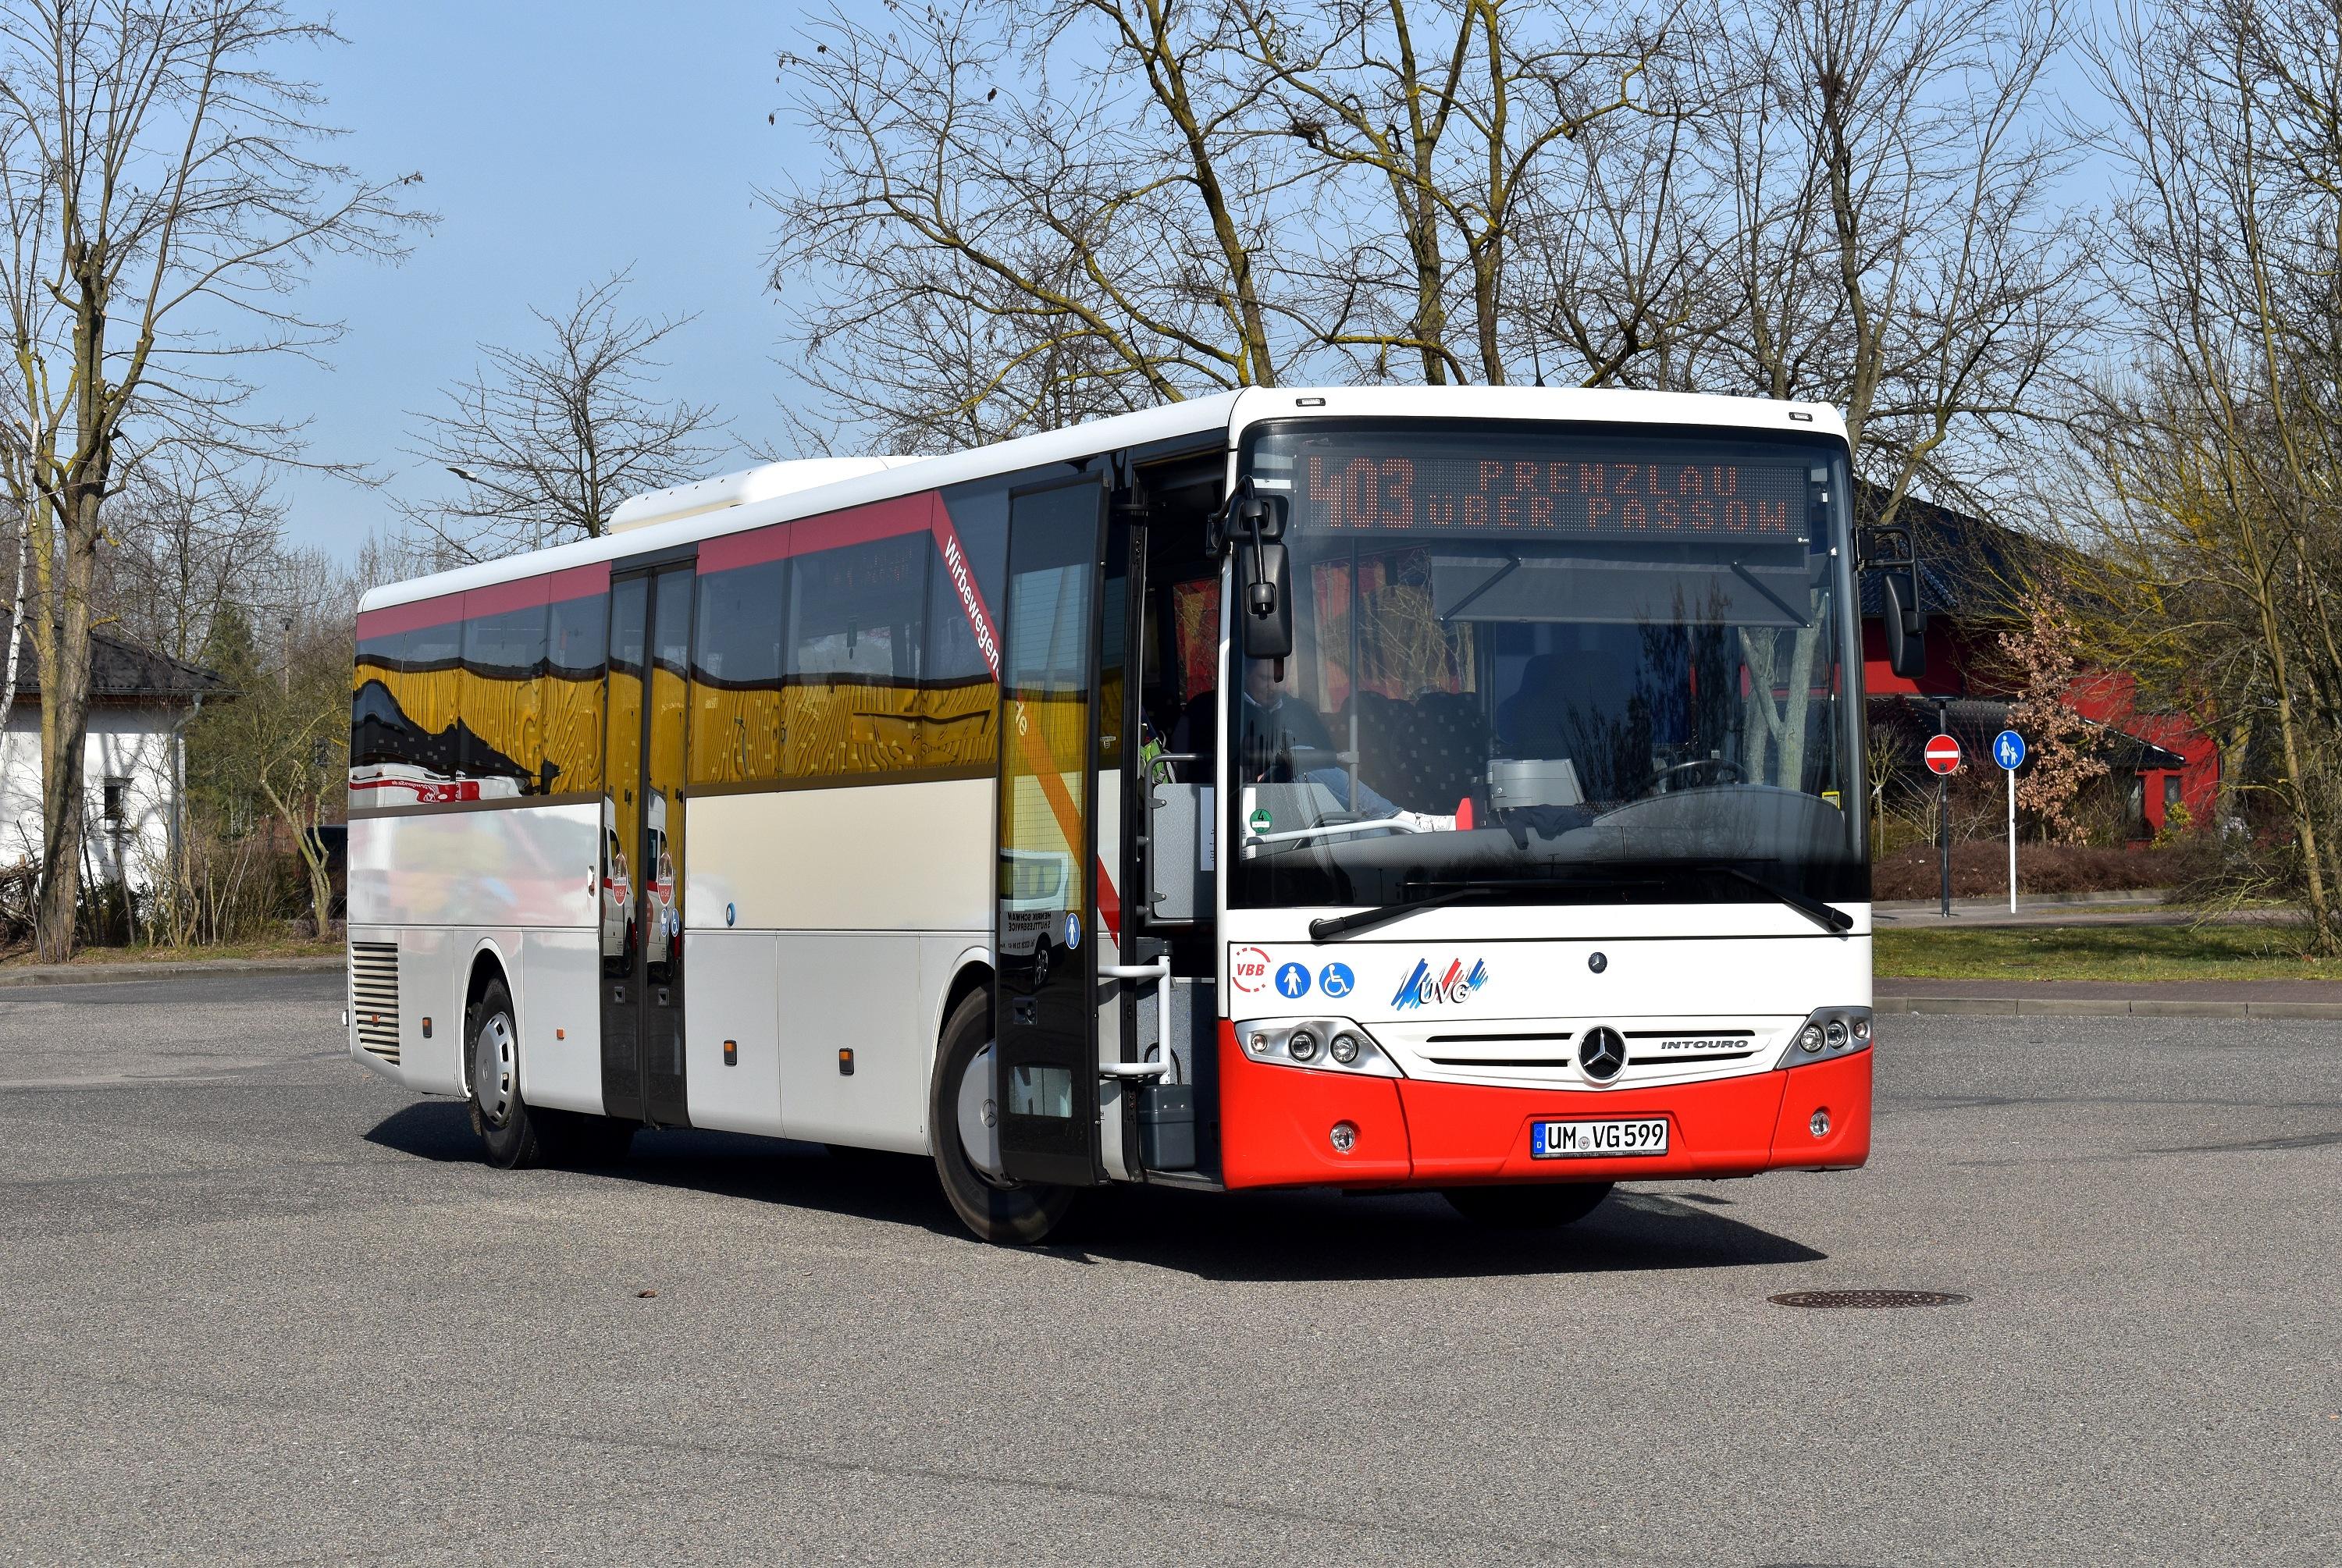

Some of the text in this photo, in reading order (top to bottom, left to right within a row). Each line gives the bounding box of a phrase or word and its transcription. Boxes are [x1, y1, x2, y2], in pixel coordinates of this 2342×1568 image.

[1479, 460, 1737, 496] PRENZLAU
[1309, 457, 1414, 528] 403
[1588, 498, 1786, 532] PASSOW
[945, 535, 1000, 681] Wirbewegen
[1257, 810, 1265, 822] 4
[1236, 963, 1265, 976] VBB
[1418, 980, 1472, 1004] UVG
[1660, 1040, 1749, 1050] INTOURO
[1547, 1123, 1664, 1150] UM VG 599
